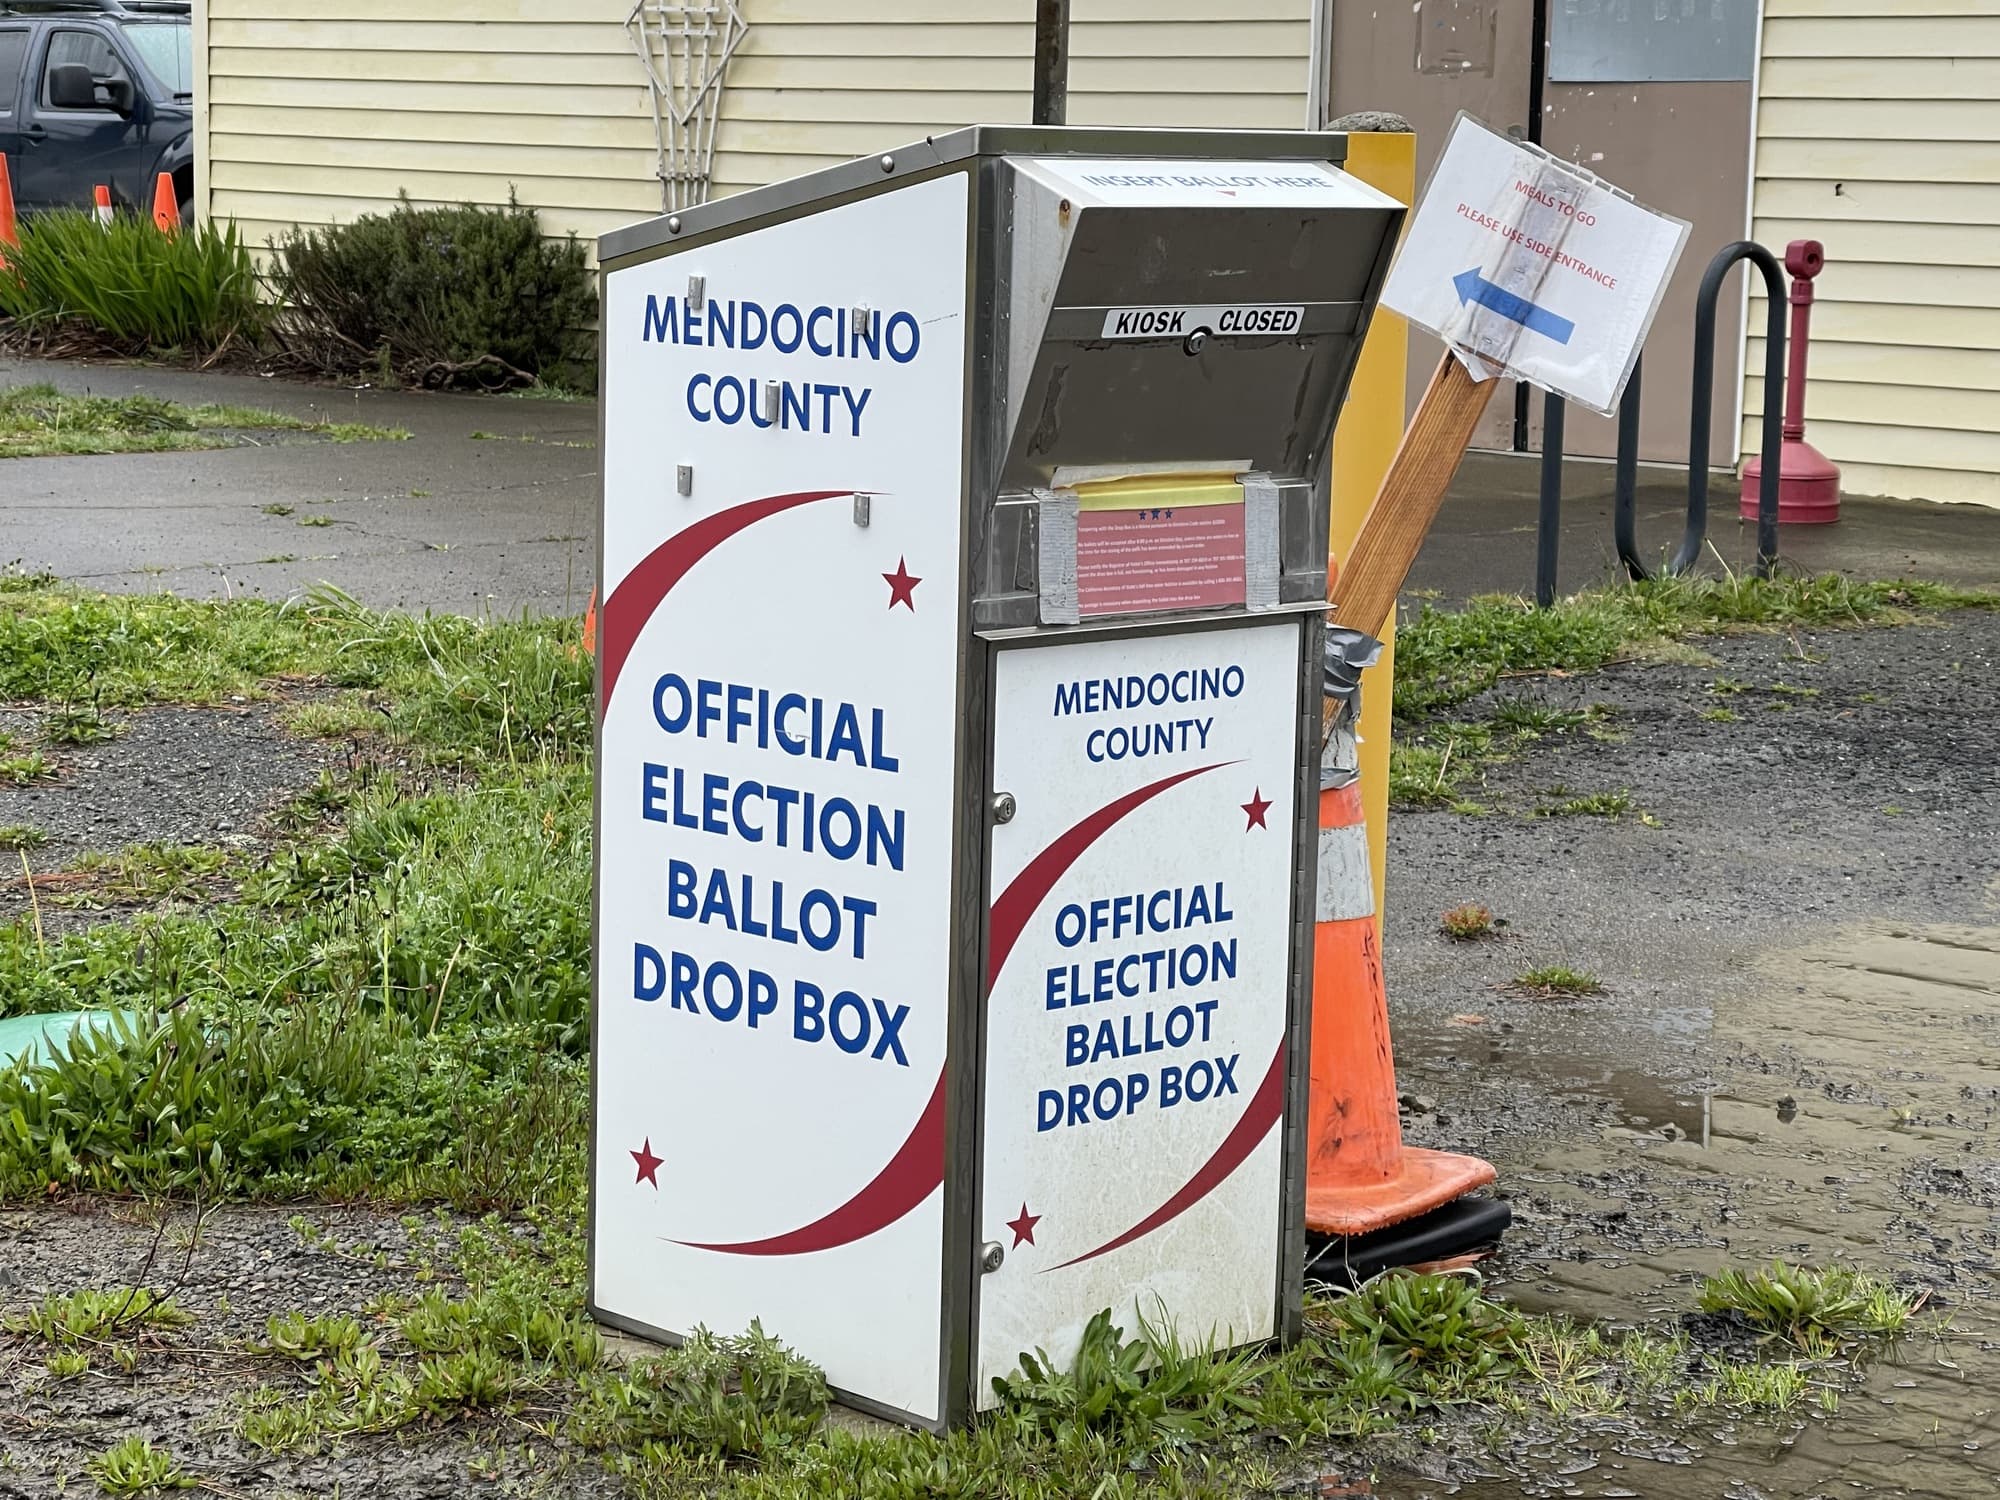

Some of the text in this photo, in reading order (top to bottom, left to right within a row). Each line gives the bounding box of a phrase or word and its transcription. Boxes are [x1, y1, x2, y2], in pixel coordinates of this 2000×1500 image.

[1082, 175, 1334, 188] INSERT BALLOT HERE
[1514, 180, 1596, 227] MEALS TO GO
[1456, 203, 1618, 290] PLEASE USE SIDE ENTRANCE
[644, 295, 920, 364] MENDOCINO
[1115, 309, 1298, 335] KIOSK CLOSED
[687, 373, 872, 437] COUNTY
[653, 673, 899, 772] OFFICIAL
[1055, 665, 1244, 716] MENDOCINO
[1087, 717, 1213, 763] COUNTY
[643, 763, 905, 871] ELECTION
[669, 860, 877, 959] BALLOT
[1056, 882, 1233, 948] OFFICIAL
[635, 942, 910, 1066] DROP BOX
[1047, 939, 1237, 1011] ELECTION
[1067, 1000, 1218, 1067] BALLOT
[1038, 1054, 1239, 1132] DROP BOX
